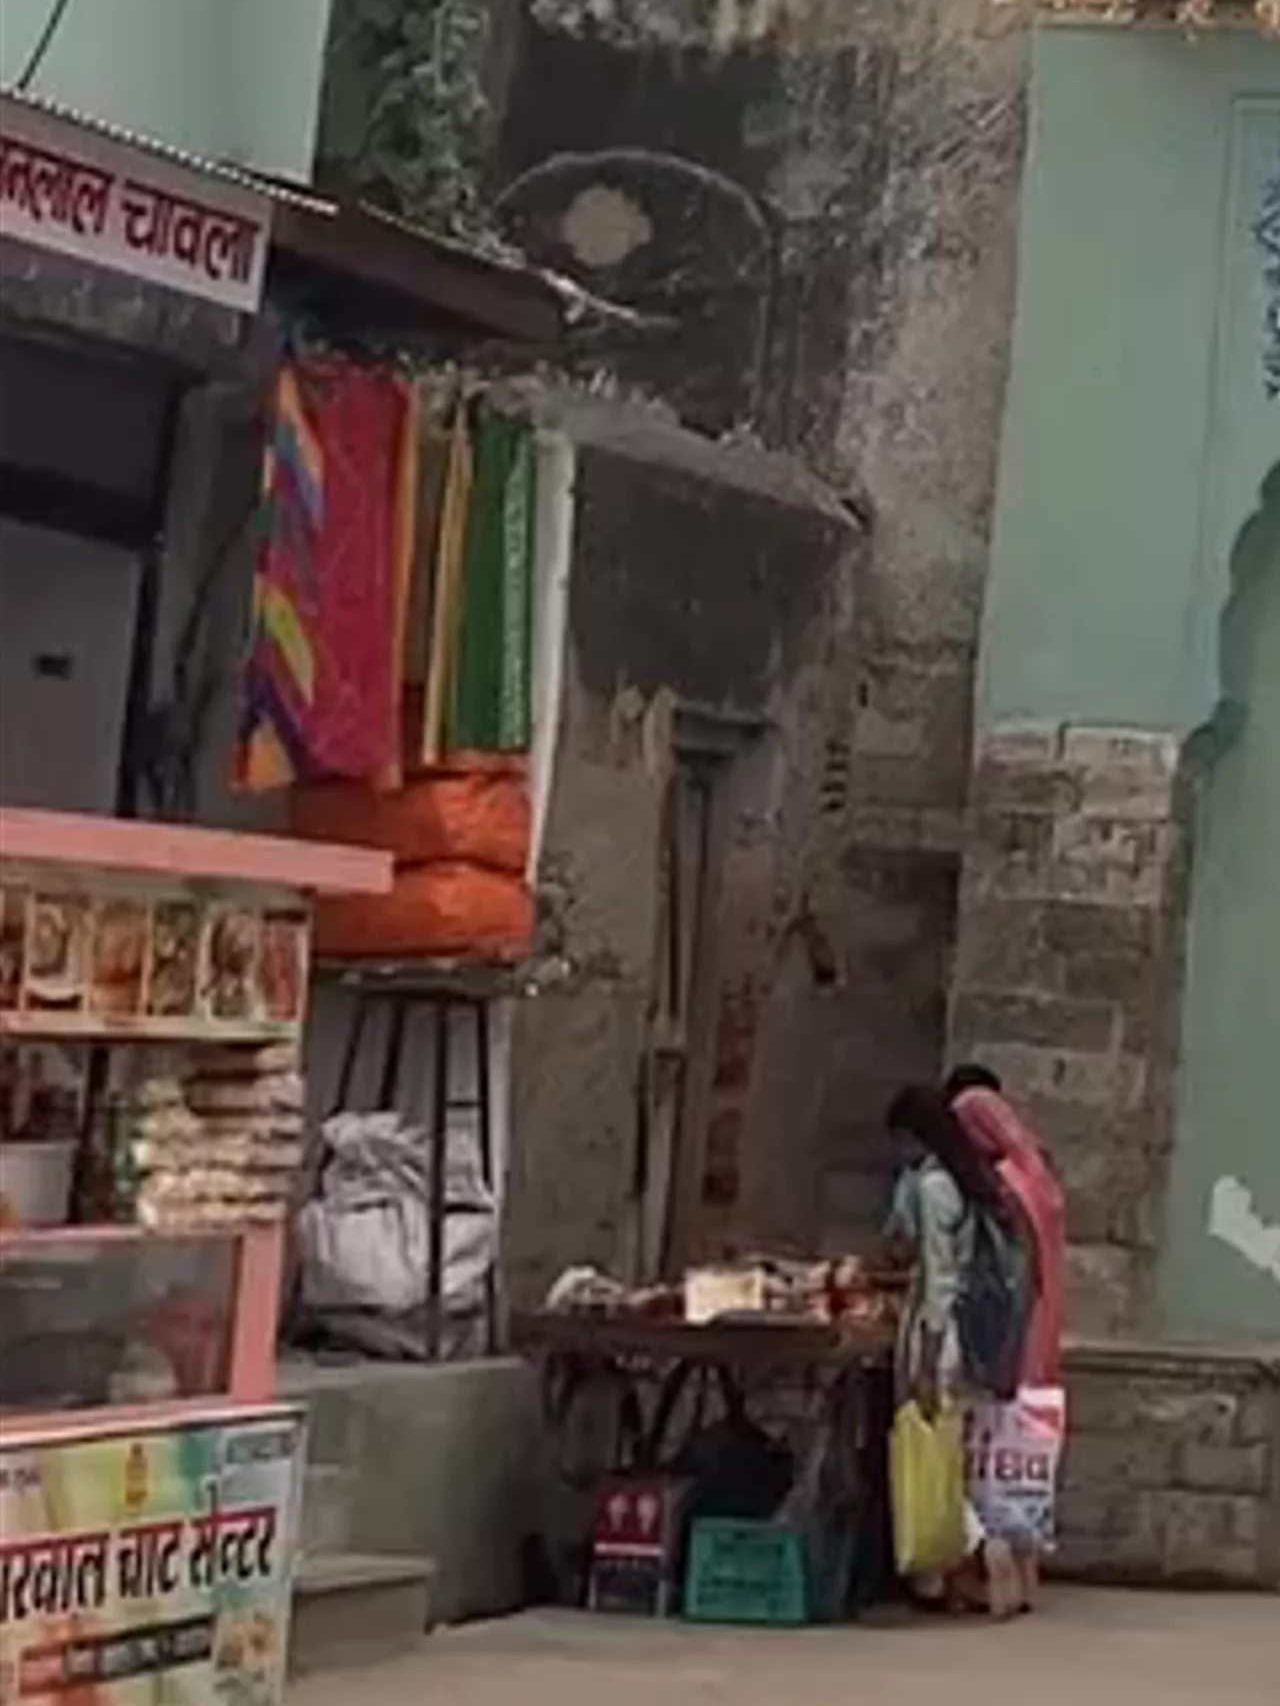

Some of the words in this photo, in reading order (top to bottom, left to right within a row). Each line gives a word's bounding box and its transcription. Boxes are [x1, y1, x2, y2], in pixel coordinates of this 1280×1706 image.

[121, 179, 262, 284] चावला
[0, 1532, 109, 1624] रवाल
[117, 1520, 188, 1598] चाट
